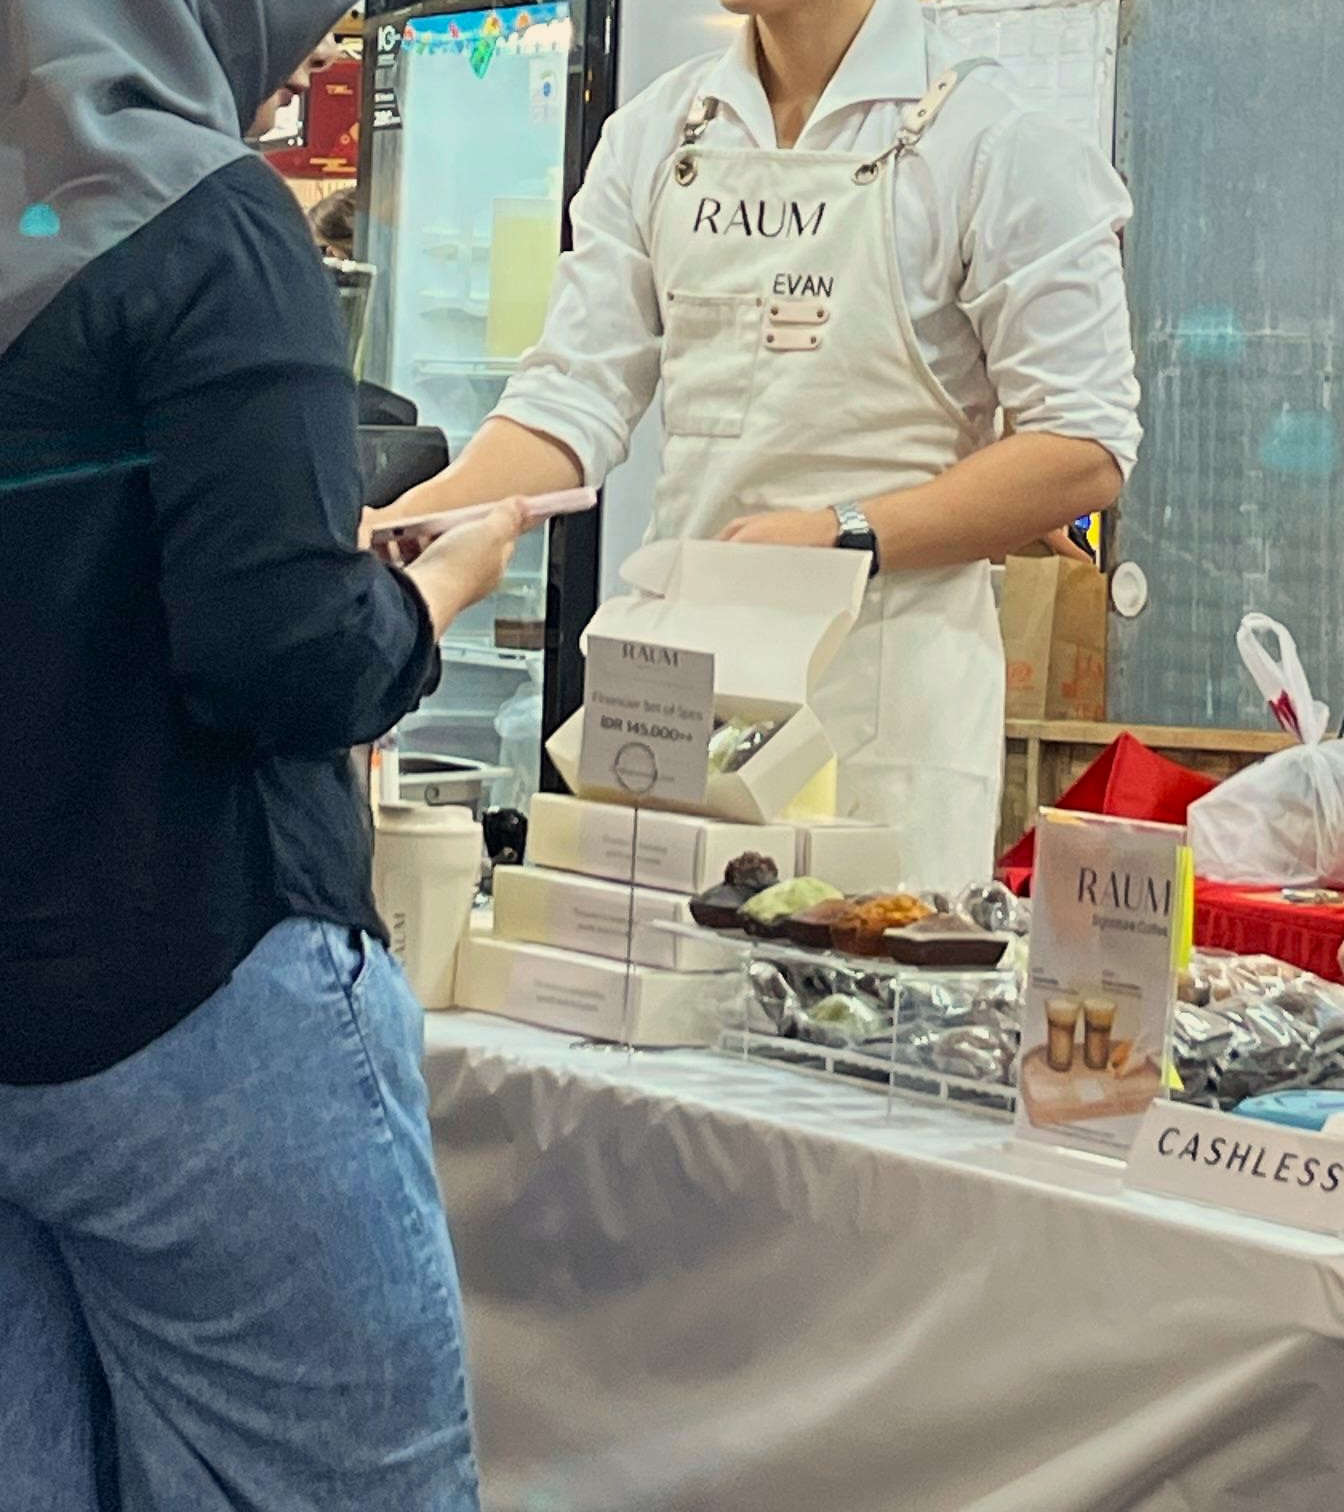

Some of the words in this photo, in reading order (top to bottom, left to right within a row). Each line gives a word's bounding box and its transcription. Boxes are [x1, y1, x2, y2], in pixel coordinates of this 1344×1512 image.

[692, 196, 826, 238] RAUM
[772, 273, 834, 298] EVAN
[622, 641, 679, 668] RAUM
[1077, 866, 1172, 917] RAUM
[1157, 1126, 1344, 1193] CASHLESS
